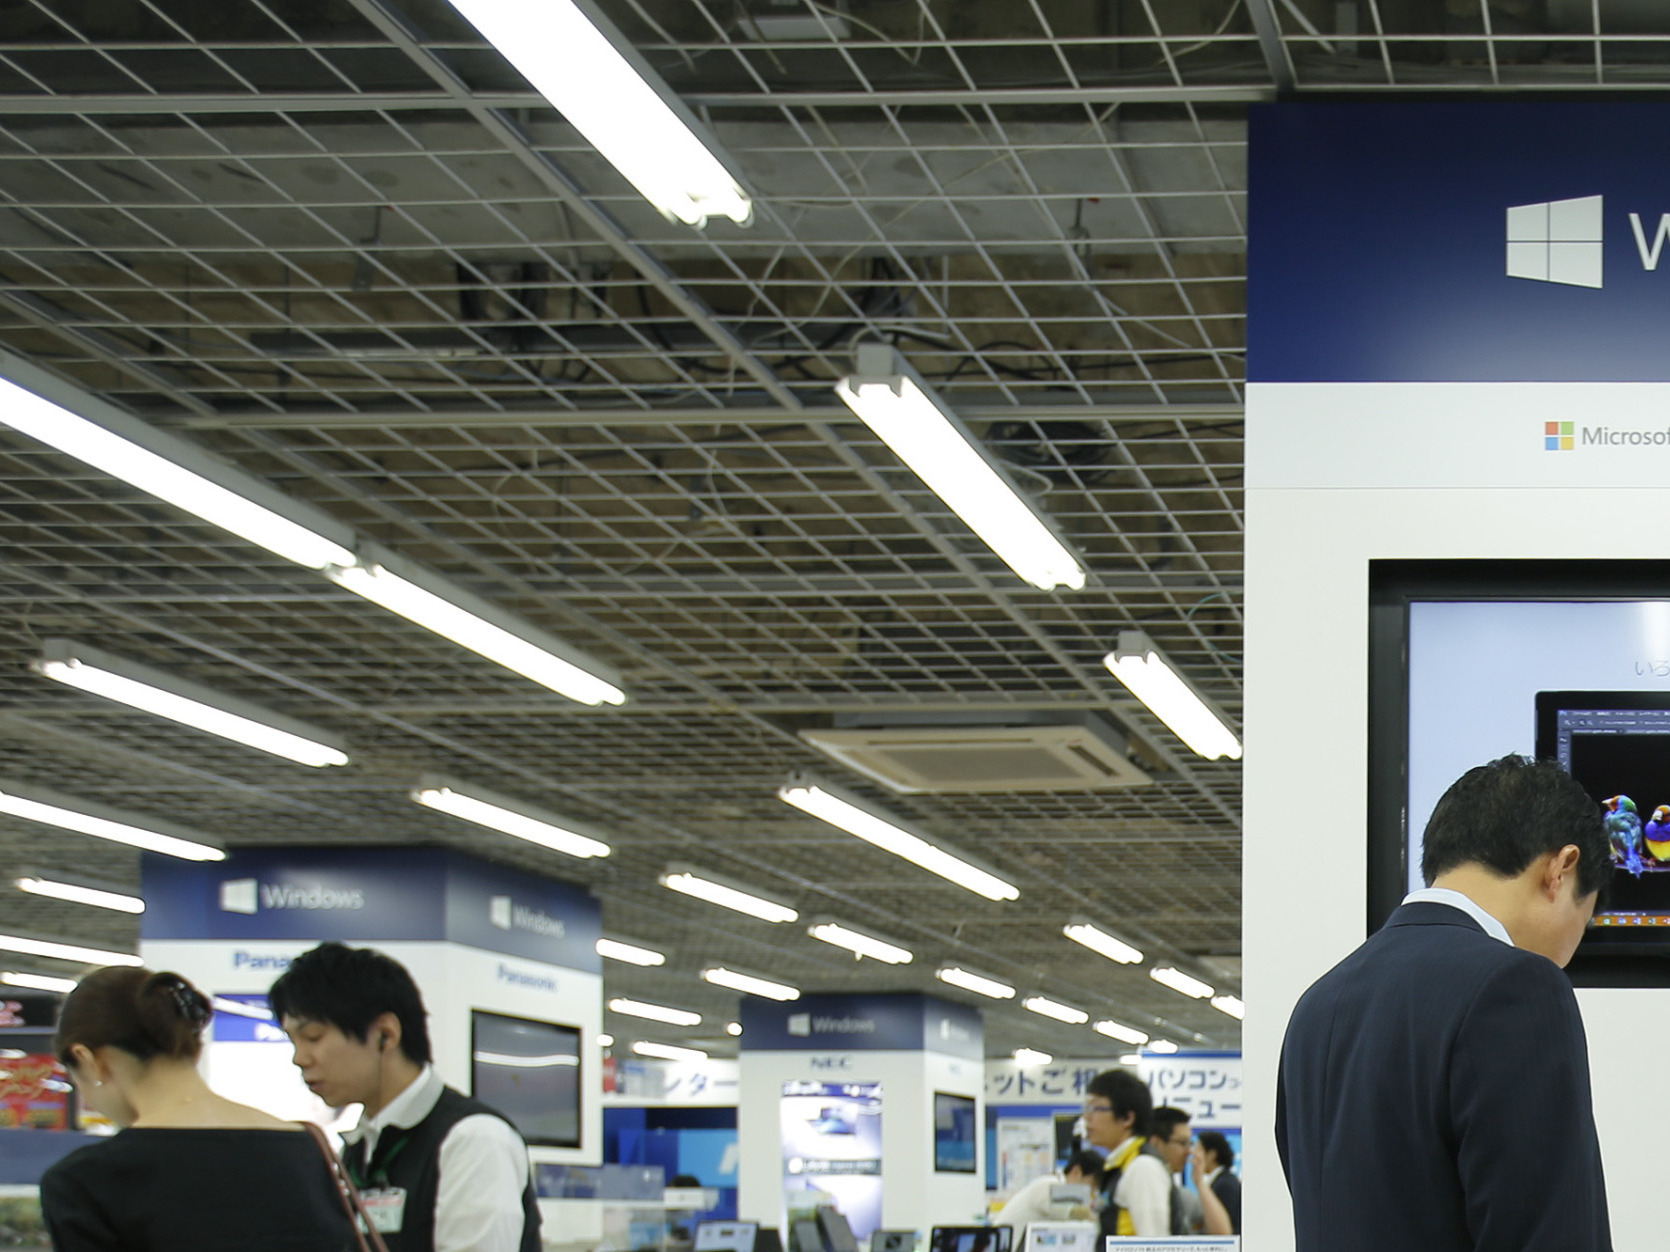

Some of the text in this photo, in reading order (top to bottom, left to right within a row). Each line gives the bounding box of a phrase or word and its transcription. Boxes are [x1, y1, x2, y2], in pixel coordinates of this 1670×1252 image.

[260, 882, 365, 910] Windows
[513, 904, 566, 939] Windows
[498, 965, 558, 992] Panasonic
[813, 1016, 876, 1034] Windows
